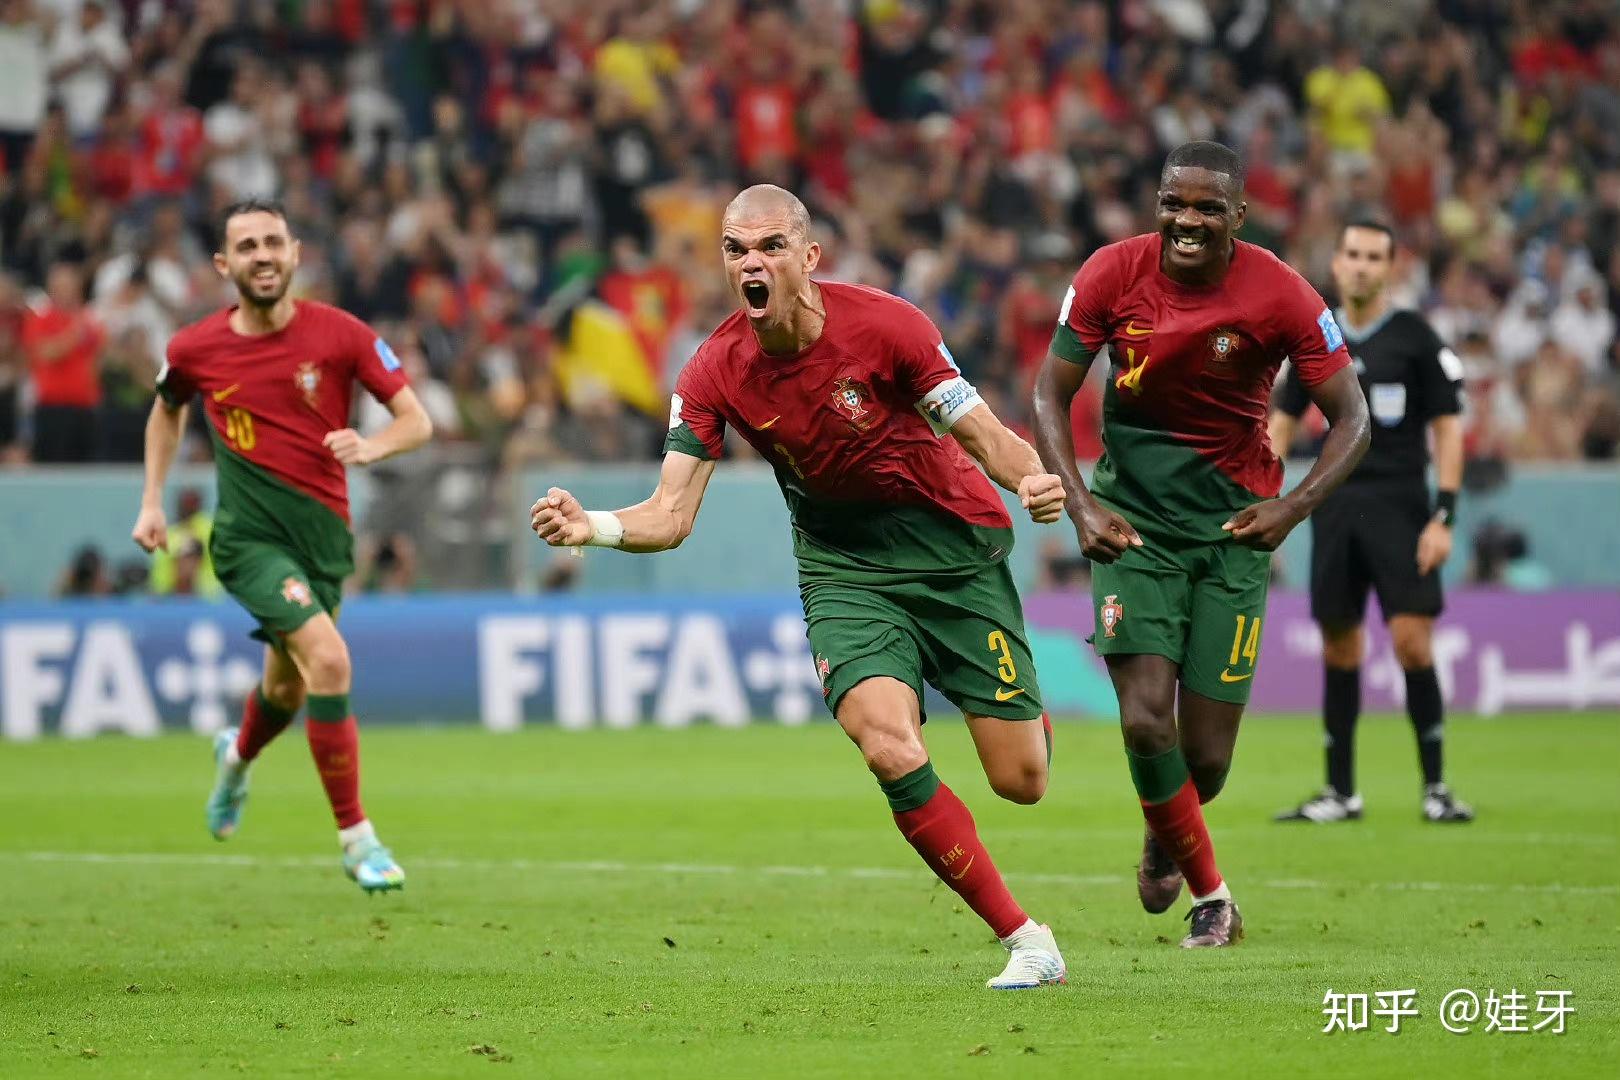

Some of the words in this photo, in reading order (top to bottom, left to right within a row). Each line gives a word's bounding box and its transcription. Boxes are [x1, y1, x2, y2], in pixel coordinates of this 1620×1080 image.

[1115, 347, 1149, 397] 14
[988, 630, 1017, 683] 3
[1230, 615, 1260, 667] 14
[1, 619, 161, 740] FA
[479, 614, 750, 731] FIFA
